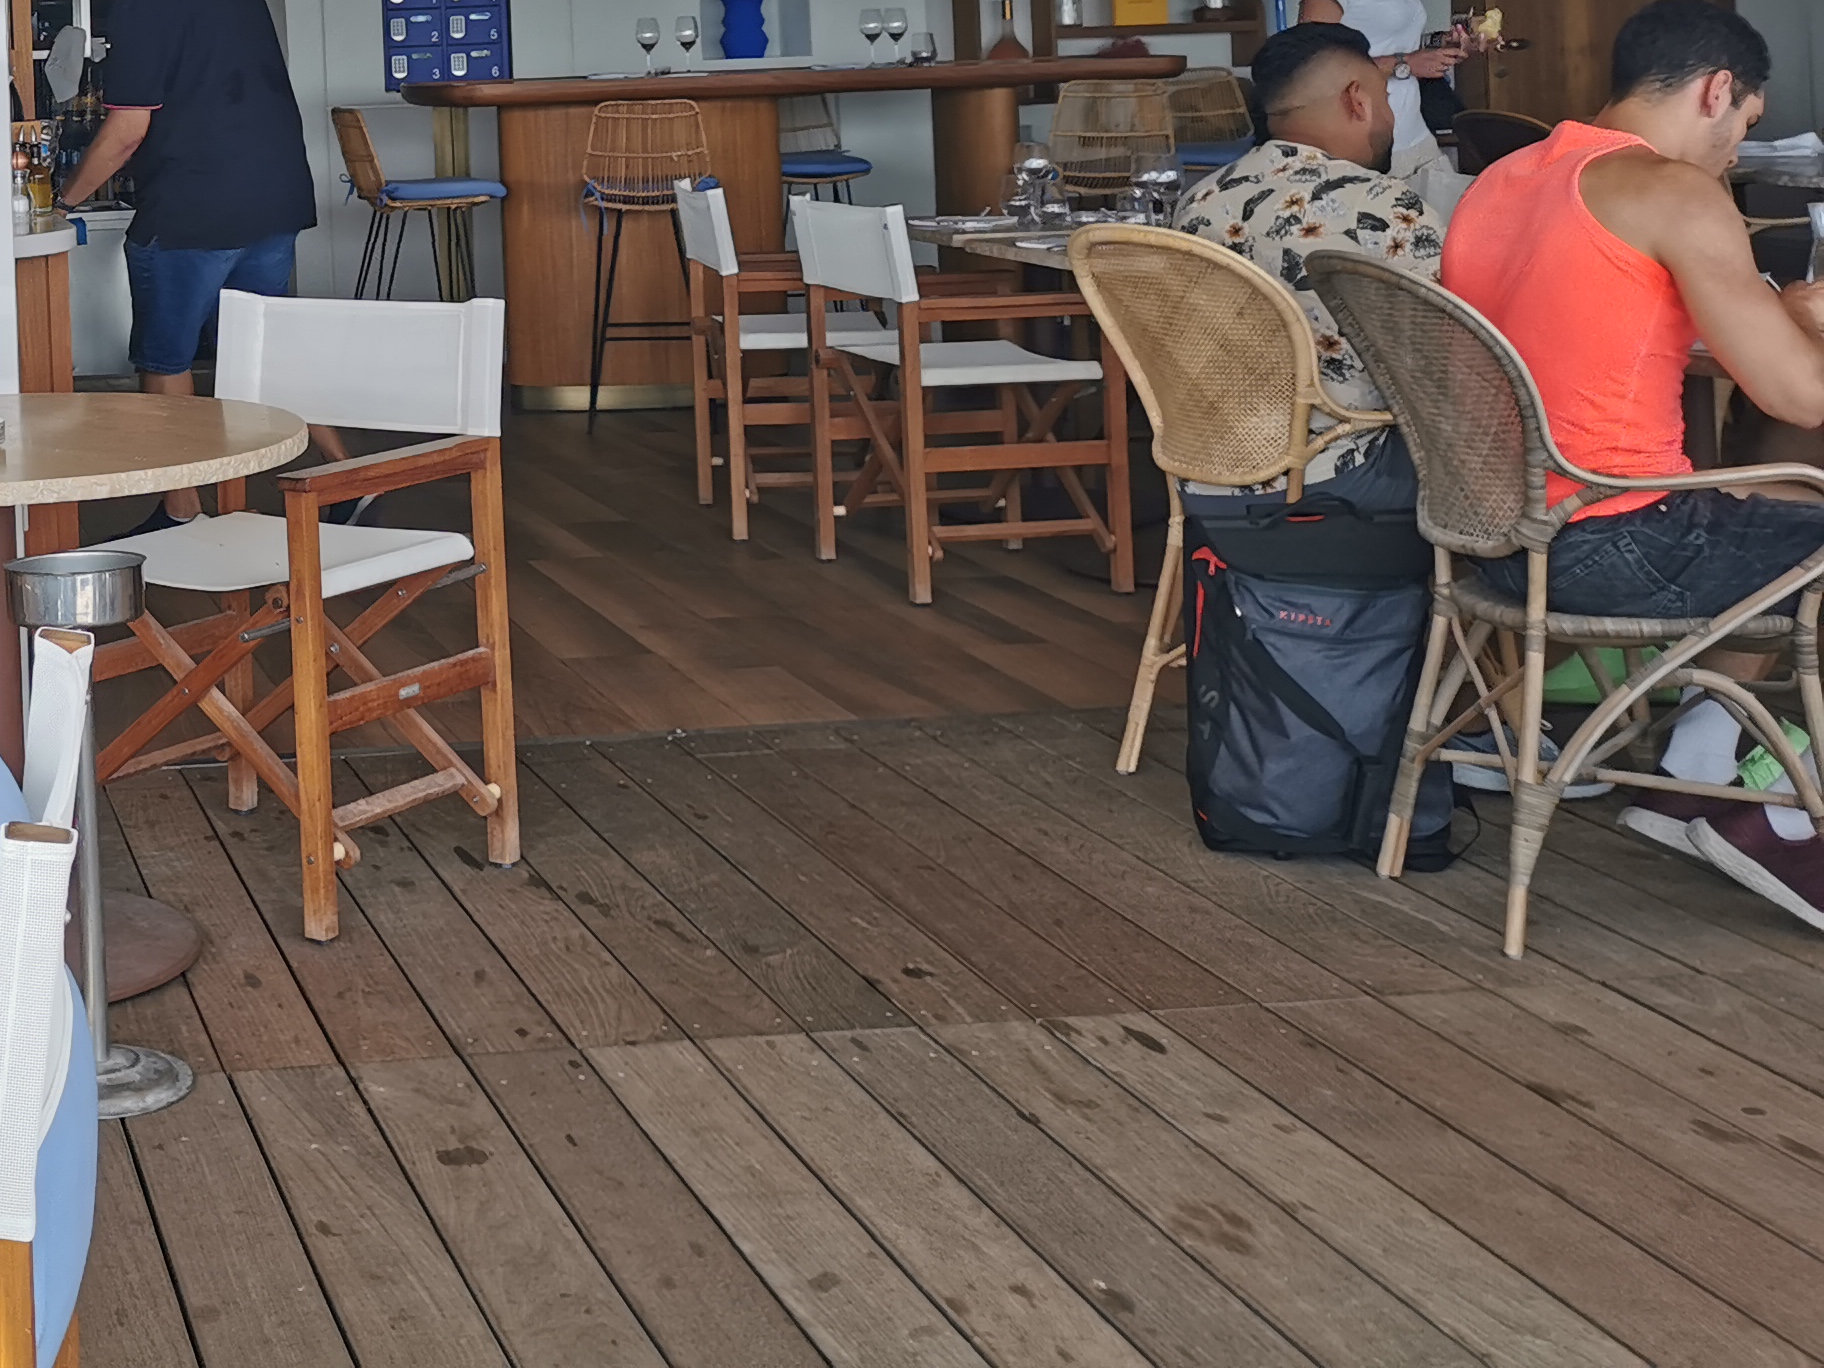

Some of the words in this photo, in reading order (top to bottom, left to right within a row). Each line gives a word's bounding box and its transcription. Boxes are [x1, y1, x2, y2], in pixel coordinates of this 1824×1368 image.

[431, 31, 440, 42] 2
[490, 29, 498, 39] 5
[432, 68, 441, 79] 3
[491, 65, 500, 77] 6
[1279, 610, 1332, 627] KIPSTA
